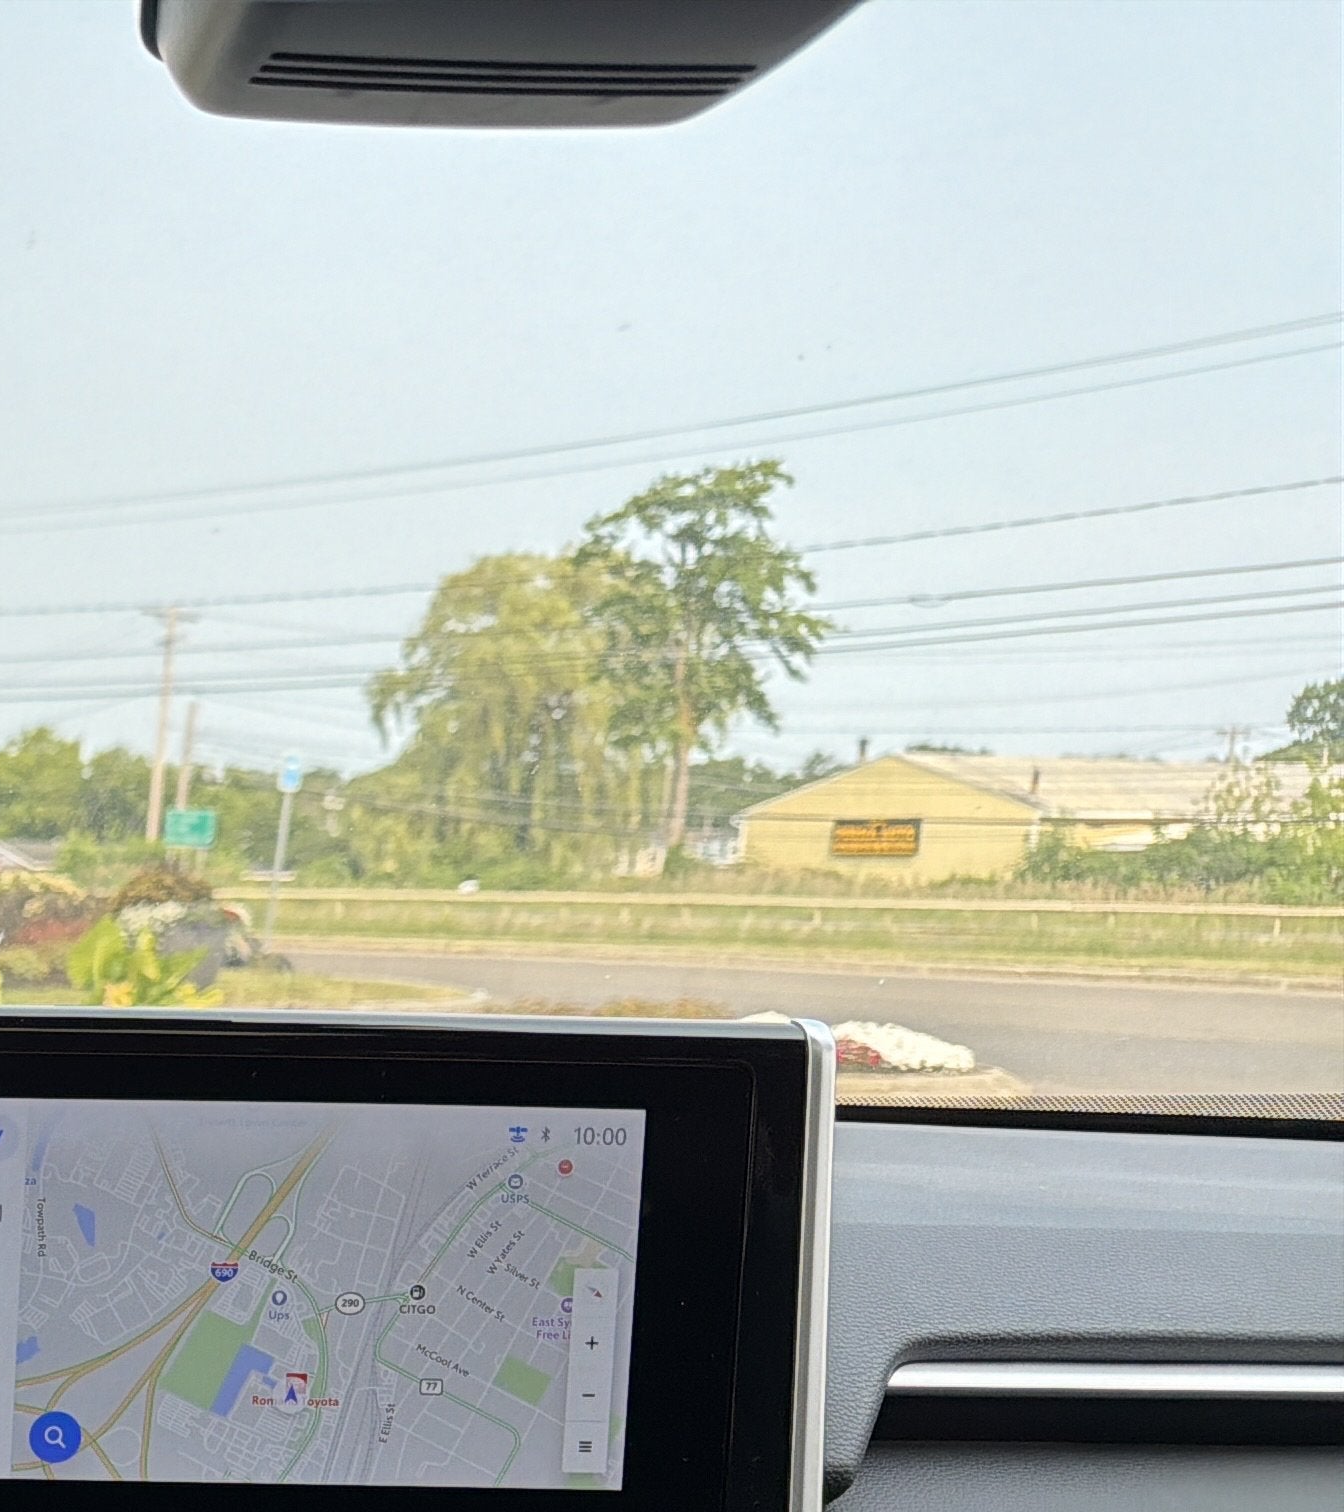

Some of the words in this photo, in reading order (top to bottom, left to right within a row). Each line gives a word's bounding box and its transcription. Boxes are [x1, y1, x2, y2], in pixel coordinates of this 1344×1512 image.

[574, 1127, 627, 1146] 10:00
[466, 1179, 476, 1190] W
[477, 1156, 508, 1182] Terrace
[508, 1147, 518, 1159] St
[501, 1194, 530, 1204] USPS
[36, 1198, 47, 1242] Towpath
[467, 1248, 477, 1258] W
[475, 1230, 492, 1249] Ellis
[492, 1220, 502, 1232] St
[37, 1245, 47, 1257] Rd
[486, 1264, 498, 1275] W
[495, 1241, 516, 1264] Yates
[514, 1230, 525, 1242] St
[215, 1269, 234, 1277] 690
[249, 1250, 285, 1275] Bridge
[285, 1269, 298, 1284] St
[504, 1264, 528, 1282] Silver
[530, 1278, 540, 1289] St
[341, 1299, 360, 1308] 290
[399, 1305, 436, 1315] CITGO
[457, 1286, 464, 1295] N
[465, 1292, 494, 1313] Center
[495, 1311, 505, 1322] St
[269, 1311, 290, 1321] Ups
[532, 1317, 554, 1326] East
[537, 1330, 559, 1339] Free
[416, 1344, 451, 1368] McCool
[453, 1363, 470, 1377] Ave
[385, 1404, 396, 1415] St
[381, 1415, 392, 1436] Ellis
